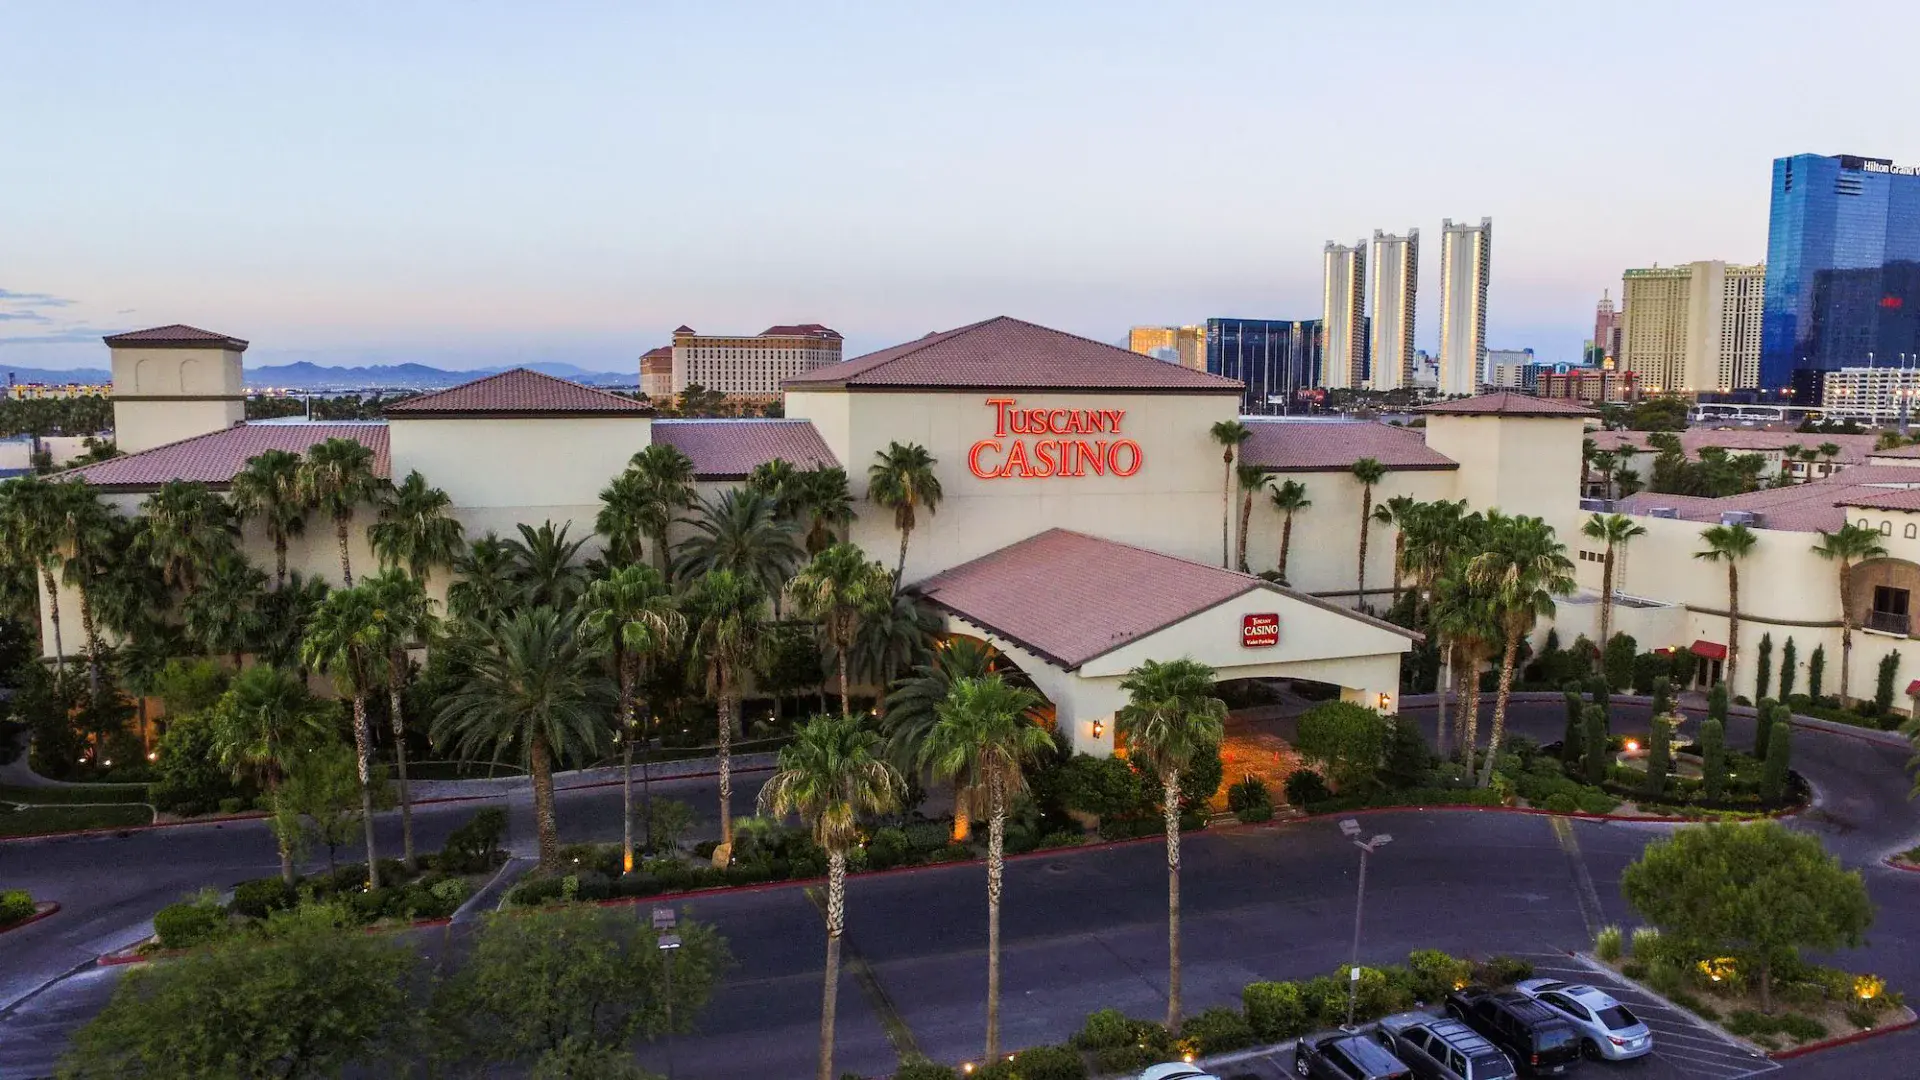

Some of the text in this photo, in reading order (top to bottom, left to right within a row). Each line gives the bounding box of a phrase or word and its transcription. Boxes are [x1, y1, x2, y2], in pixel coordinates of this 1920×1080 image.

[1863, 160, 1889, 173] Hilton
[1890, 163, 1914, 175] Grand
[986, 398, 1126, 437] TUSCANY
[968, 438, 1143, 478] CASINO
[1244, 625, 1278, 636] CASINO
